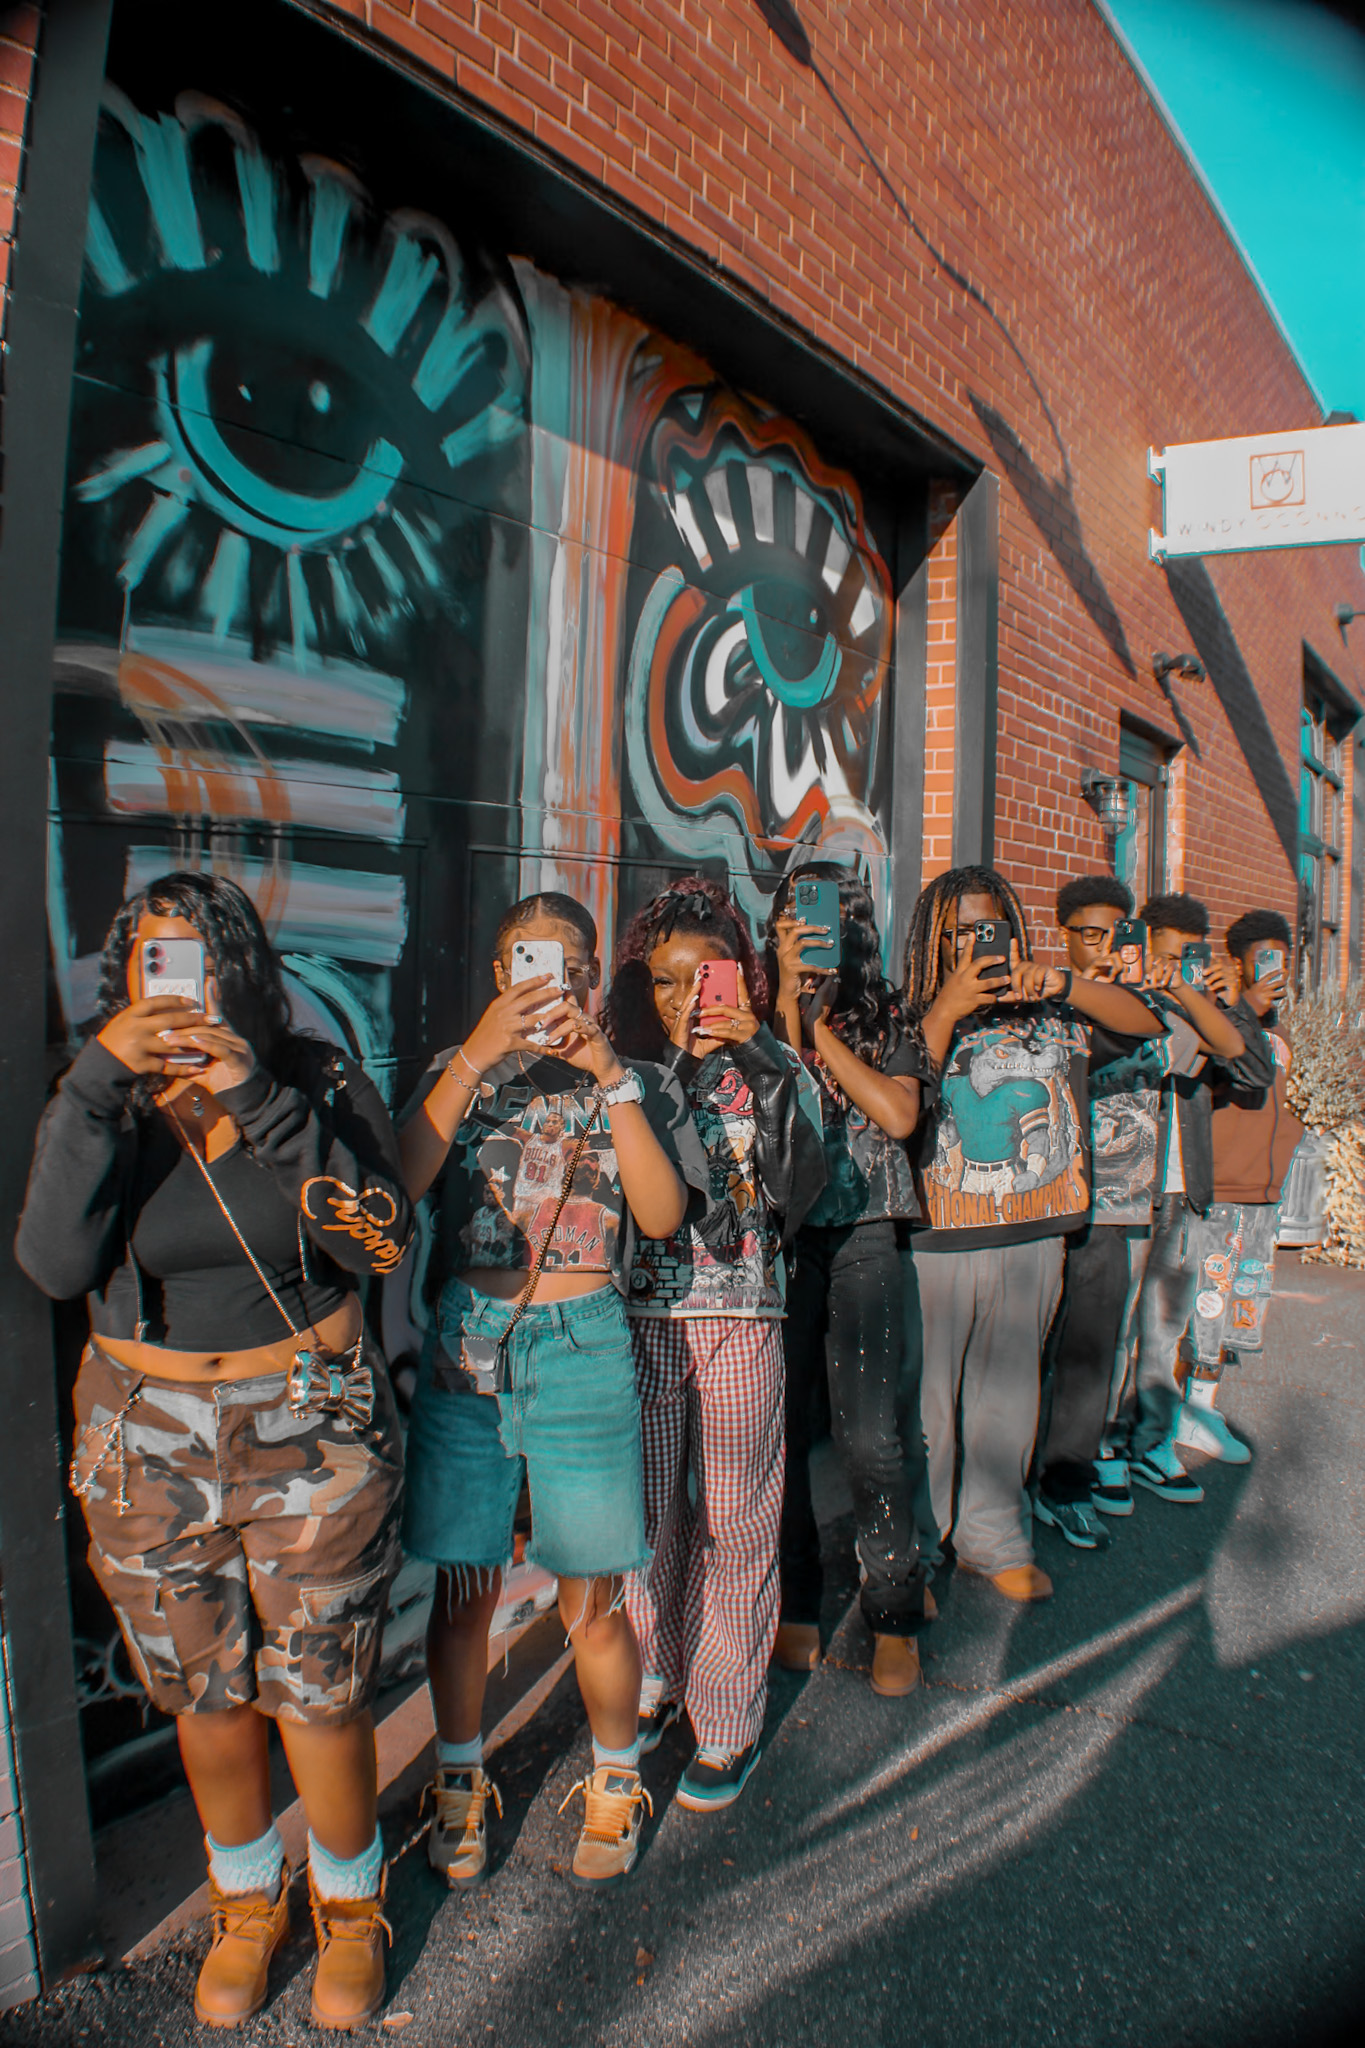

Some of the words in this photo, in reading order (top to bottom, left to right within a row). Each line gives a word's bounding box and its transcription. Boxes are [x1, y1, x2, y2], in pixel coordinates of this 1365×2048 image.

[455, 1082, 611, 1146] DENNI
[524, 1147, 557, 1167] BULLS
[525, 1161, 547, 1183] 91
[528, 1224, 600, 1253] RODMAN
